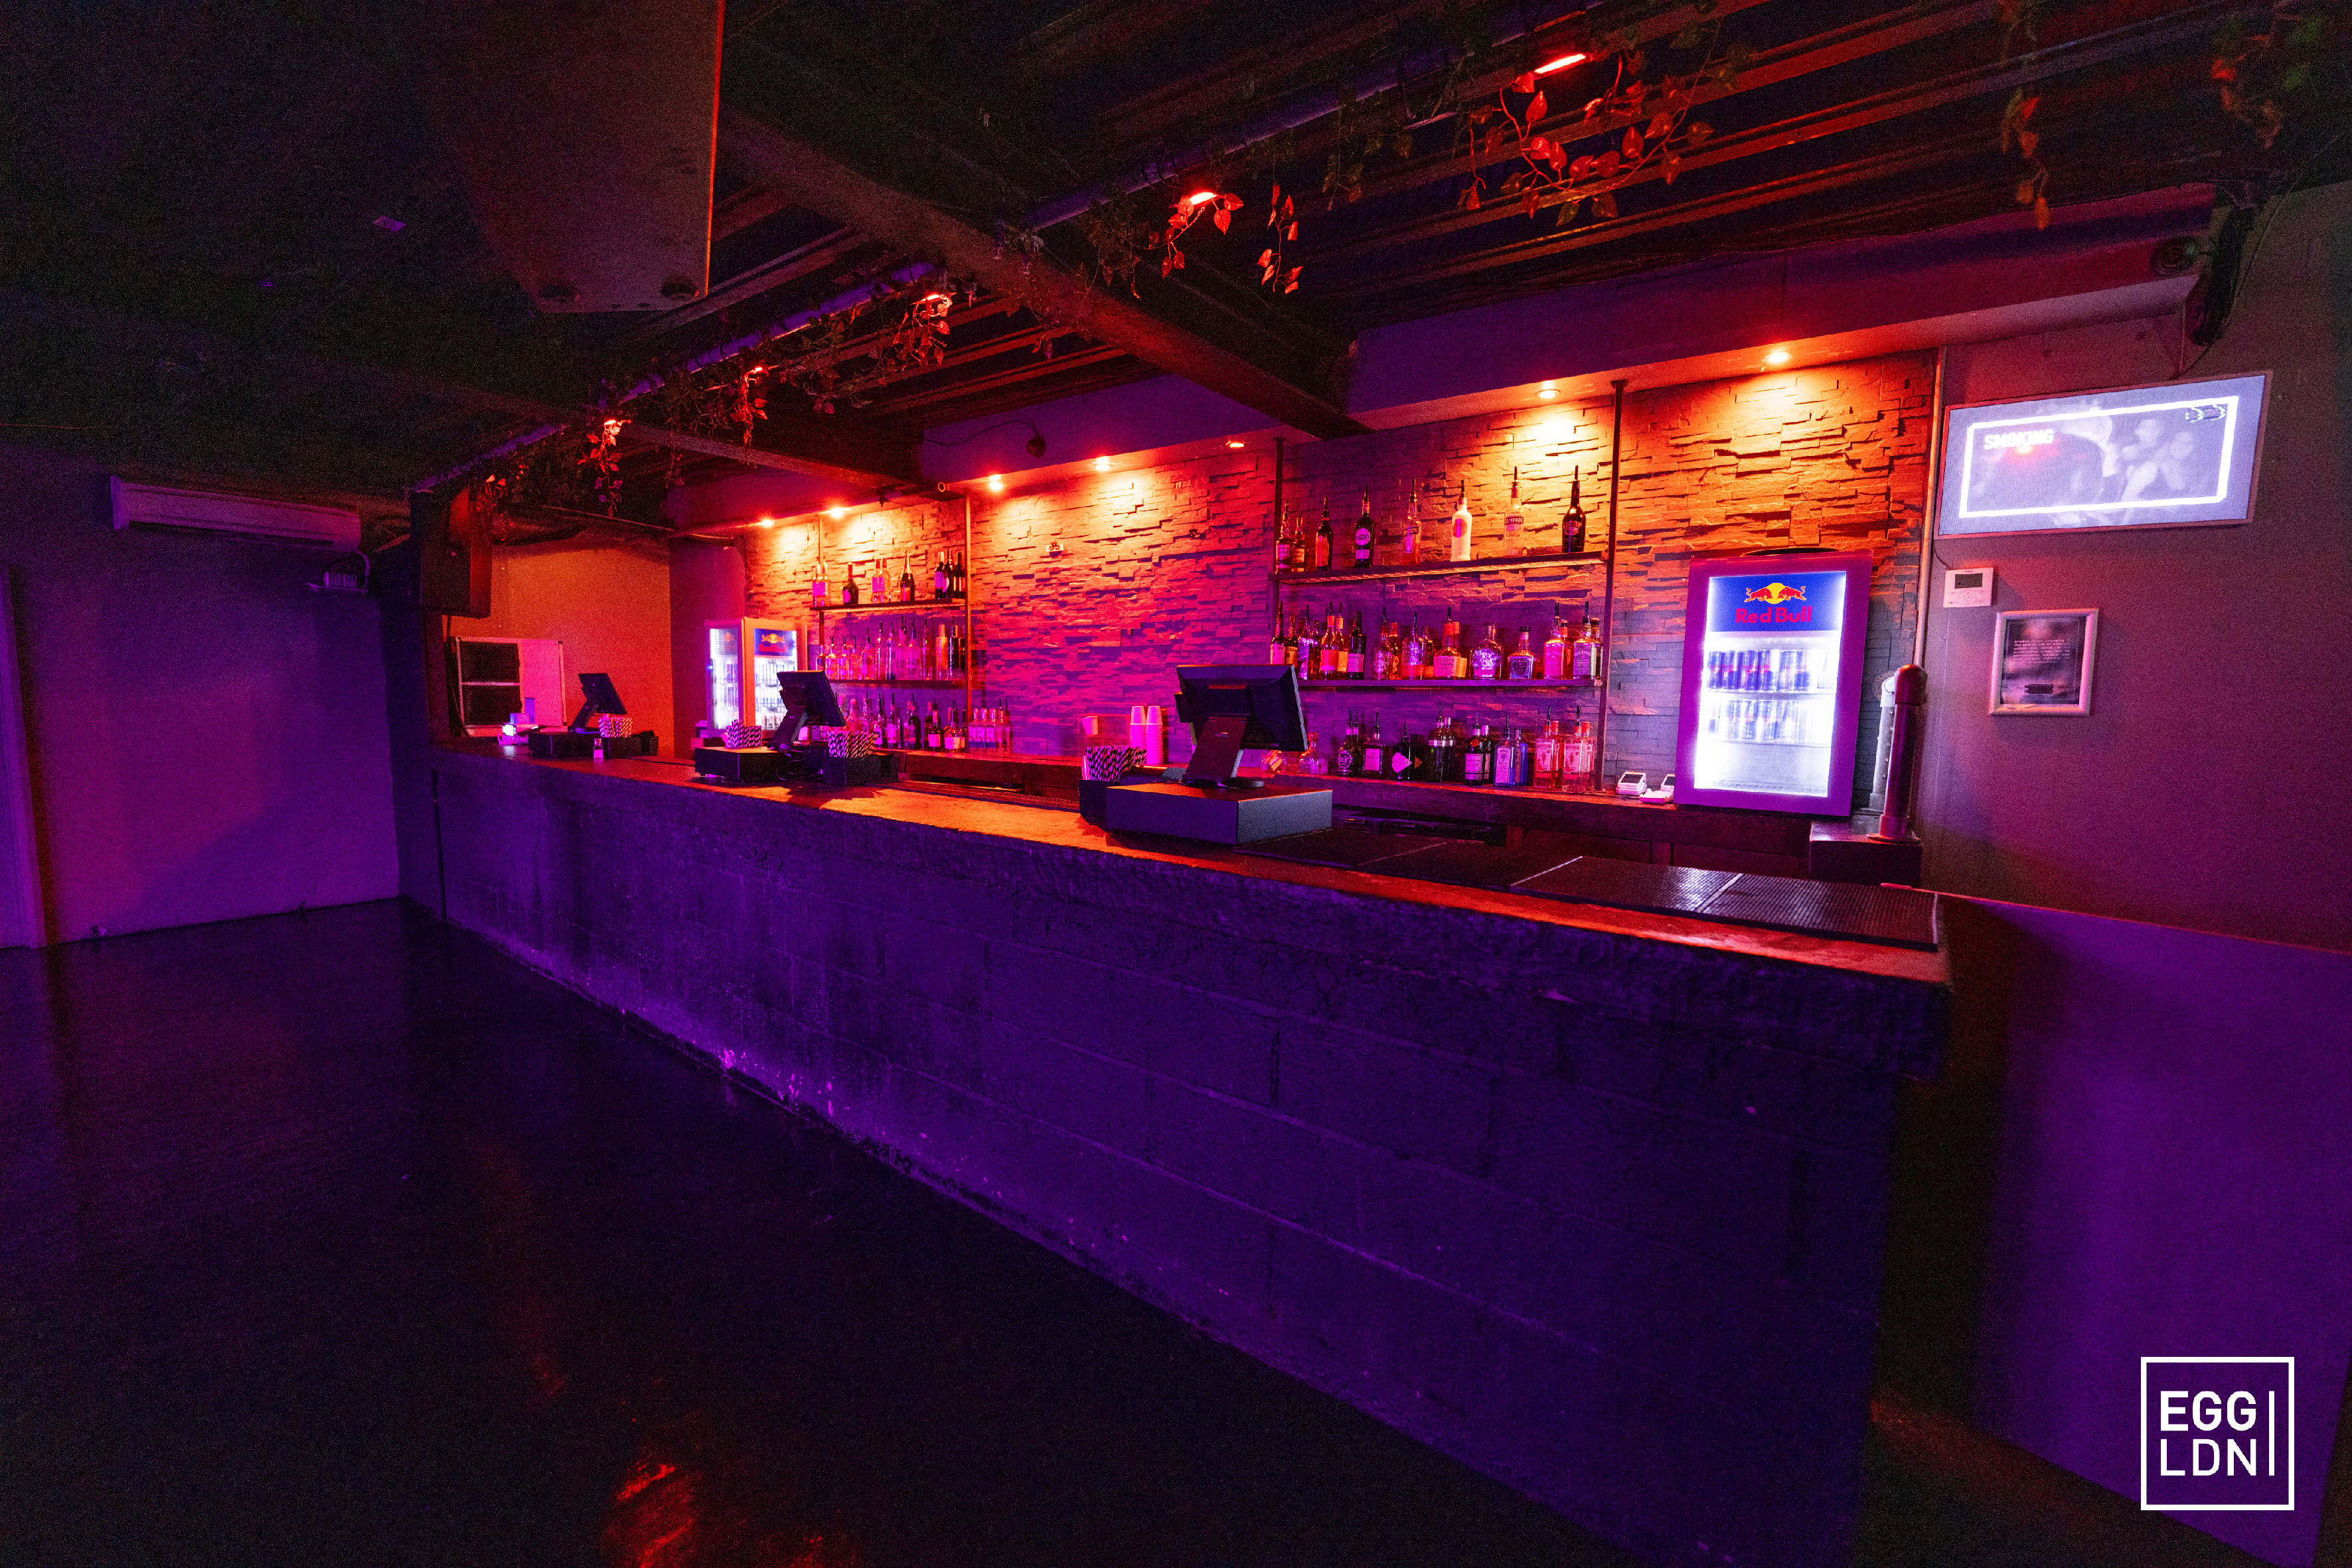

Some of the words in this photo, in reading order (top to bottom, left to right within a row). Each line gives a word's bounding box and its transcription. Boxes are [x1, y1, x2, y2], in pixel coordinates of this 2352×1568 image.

[1984, 428, 2055, 450] SMOKING
[1735, 607, 1772, 623] Red
[1775, 605, 1812, 623] Bull
